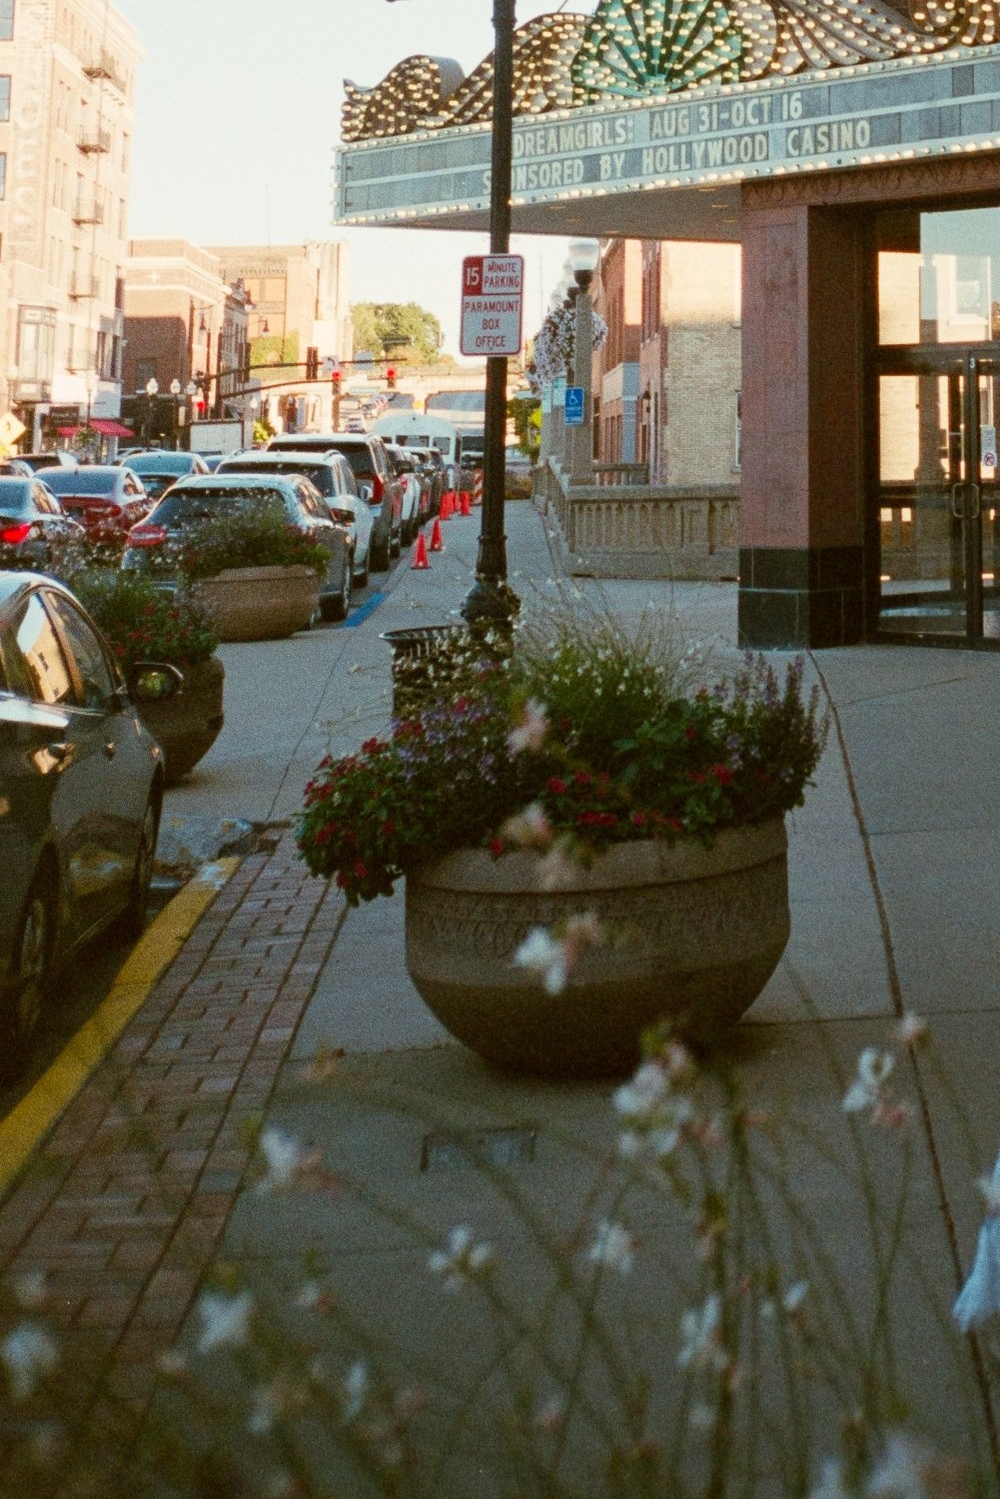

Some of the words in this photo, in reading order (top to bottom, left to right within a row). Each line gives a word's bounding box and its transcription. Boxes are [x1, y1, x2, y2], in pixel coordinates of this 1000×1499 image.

[512, 117, 634, 159] DREAMGIRLS:
[652, 107, 691, 140] AUG
[699, 97, 772, 132] 31-OCT
[782, 92, 803, 121] 16
[483, 158, 585, 195] SNSORED
[600, 152, 626, 180] BY
[641, 133, 768, 176] HOLLYWOOD
[786, 119, 871, 157] CASINO
[487, 261, 518, 273] MINUTE
[466, 266, 480, 286] 15
[484, 275, 520, 288] PARKING
[464, 301, 519, 313] PARAMOUNT
[482, 318, 500, 330] BOX
[475, 335, 506, 348] OFFICE
